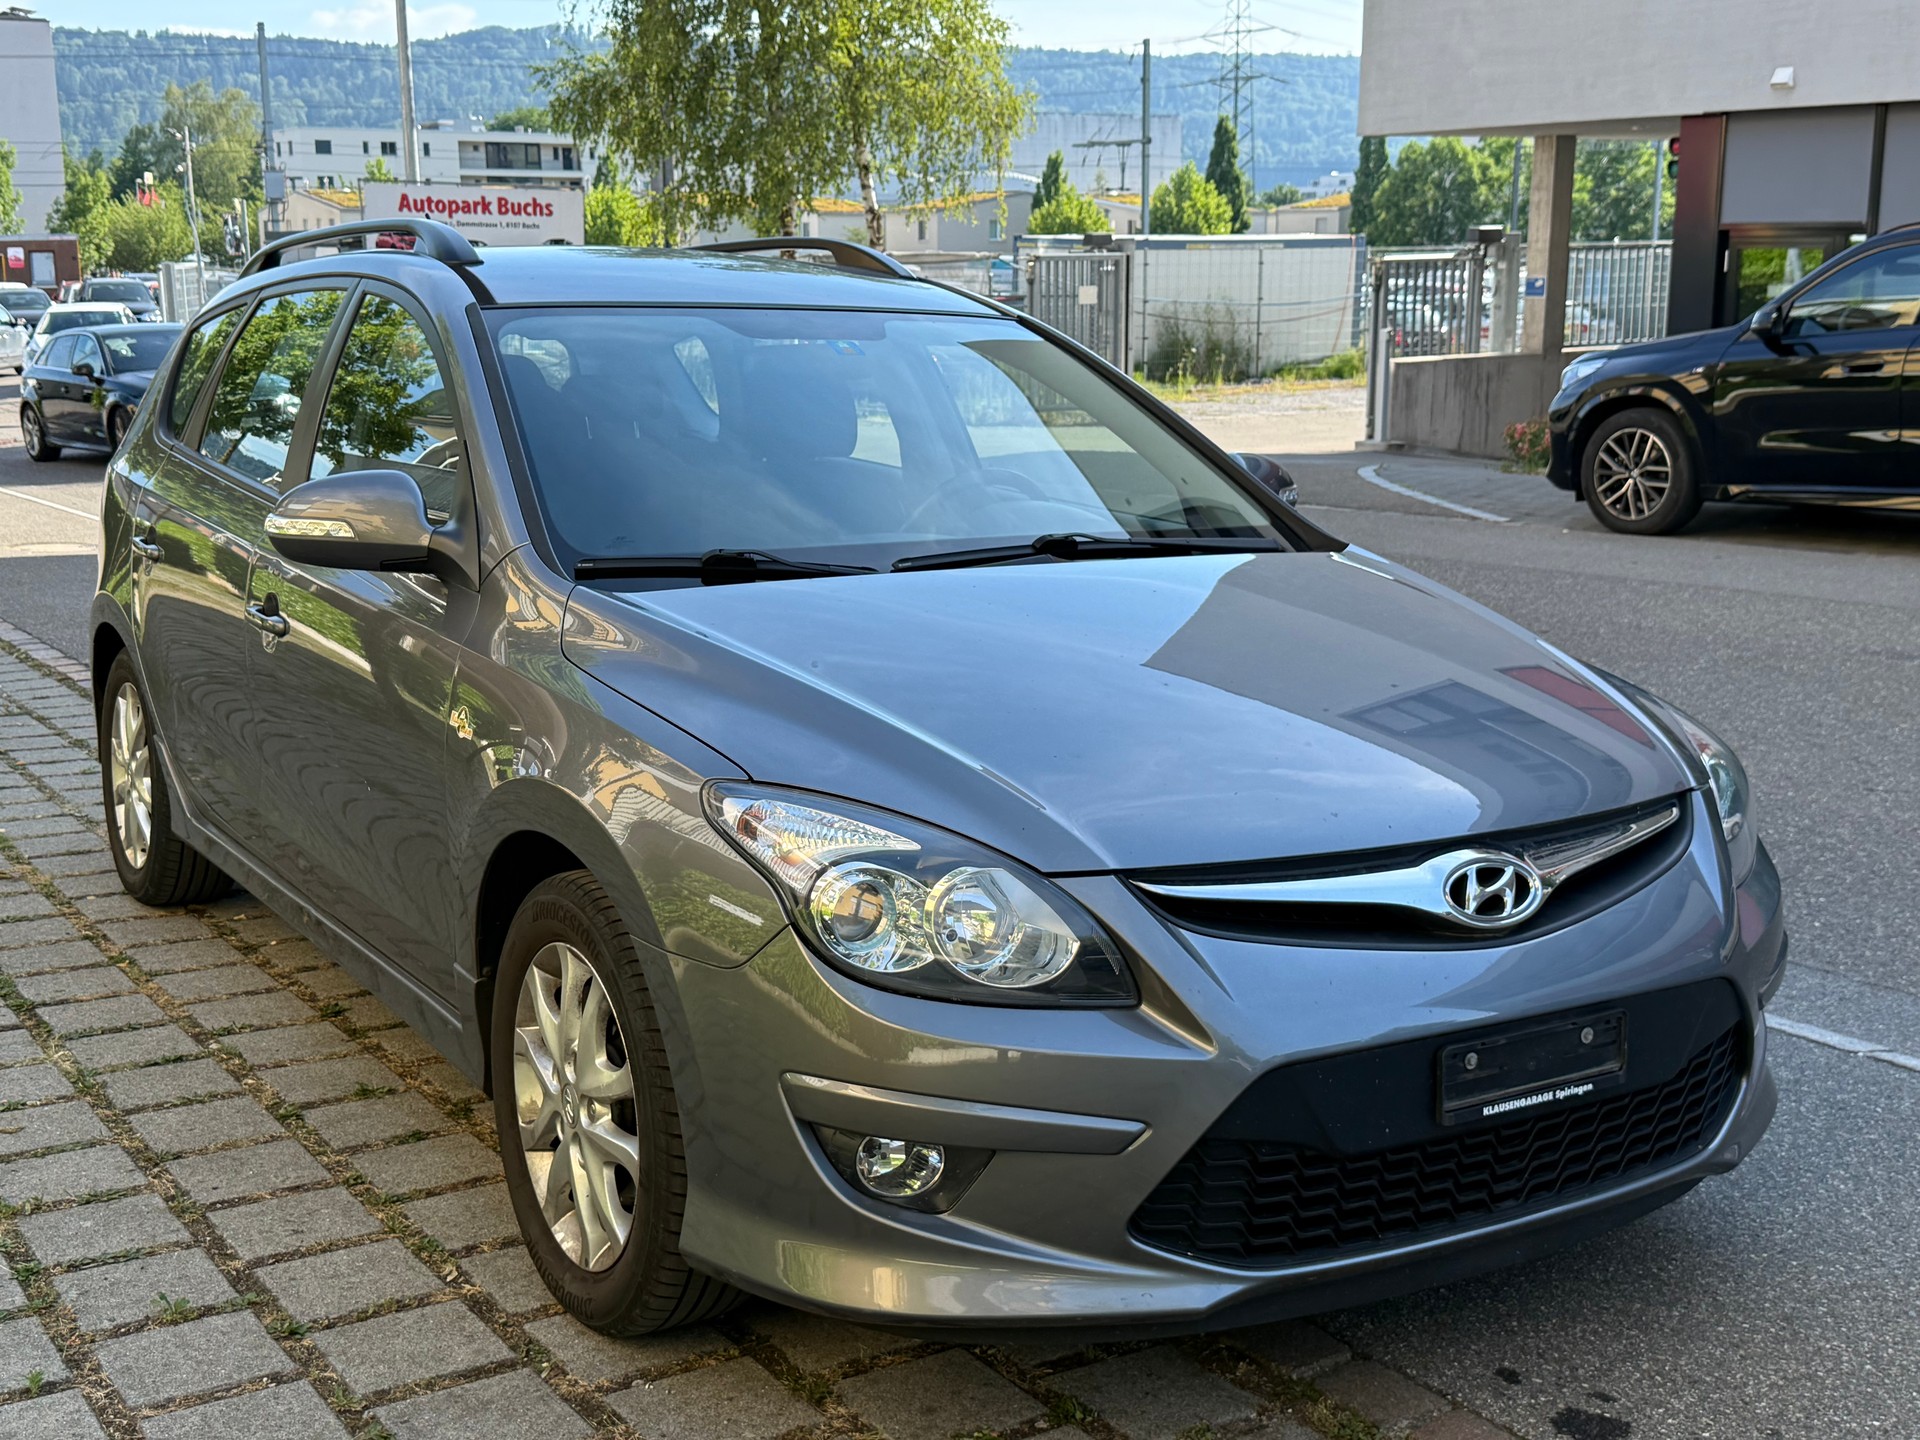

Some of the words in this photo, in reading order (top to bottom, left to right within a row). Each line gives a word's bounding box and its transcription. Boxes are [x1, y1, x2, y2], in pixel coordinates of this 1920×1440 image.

[398, 192, 493, 219] Autopark
[497, 196, 554, 217] Buchs
[456, 220, 498, 229] Dammstrasse
[522, 222, 540, 230] Buchs
[532, 899, 605, 965] BRIDGESTONE
[1482, 1091, 1555, 1116] KLAUSENGARAGE
[1555, 1083, 1594, 1099] Spiringen
